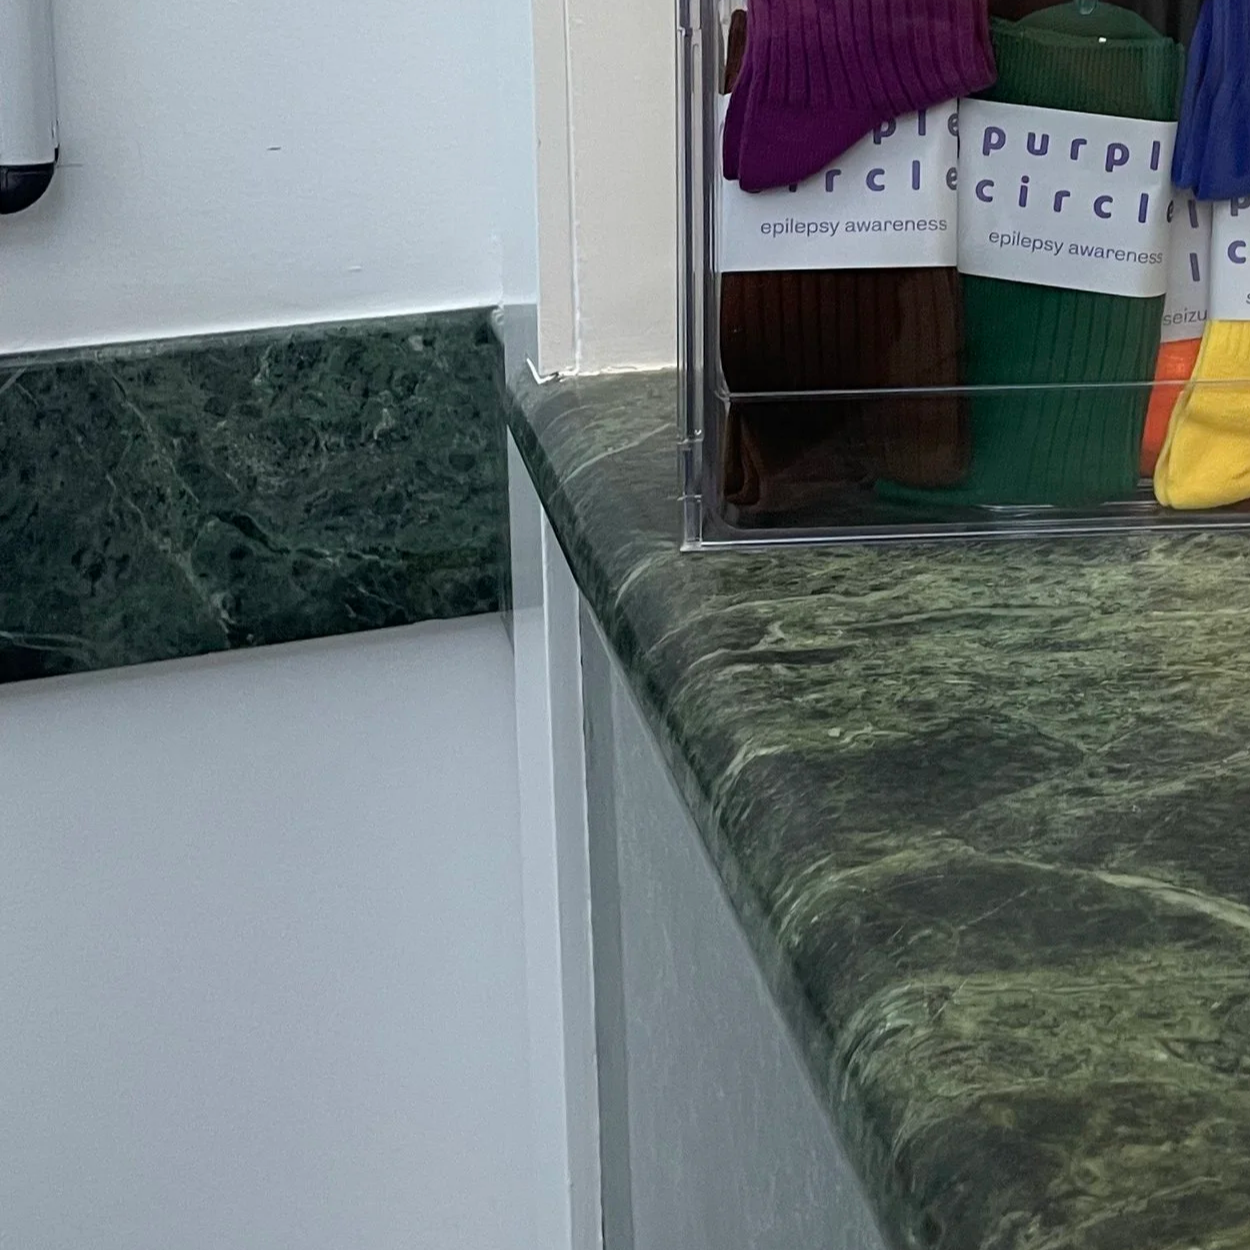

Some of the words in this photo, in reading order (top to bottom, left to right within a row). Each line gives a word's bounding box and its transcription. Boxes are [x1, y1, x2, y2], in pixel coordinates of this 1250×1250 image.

[760, 217, 840, 238] epilepsy
[844, 217, 949, 233] awareness
[988, 230, 1064, 256] epilepsy
[1068, 241, 1164, 265] awareness
